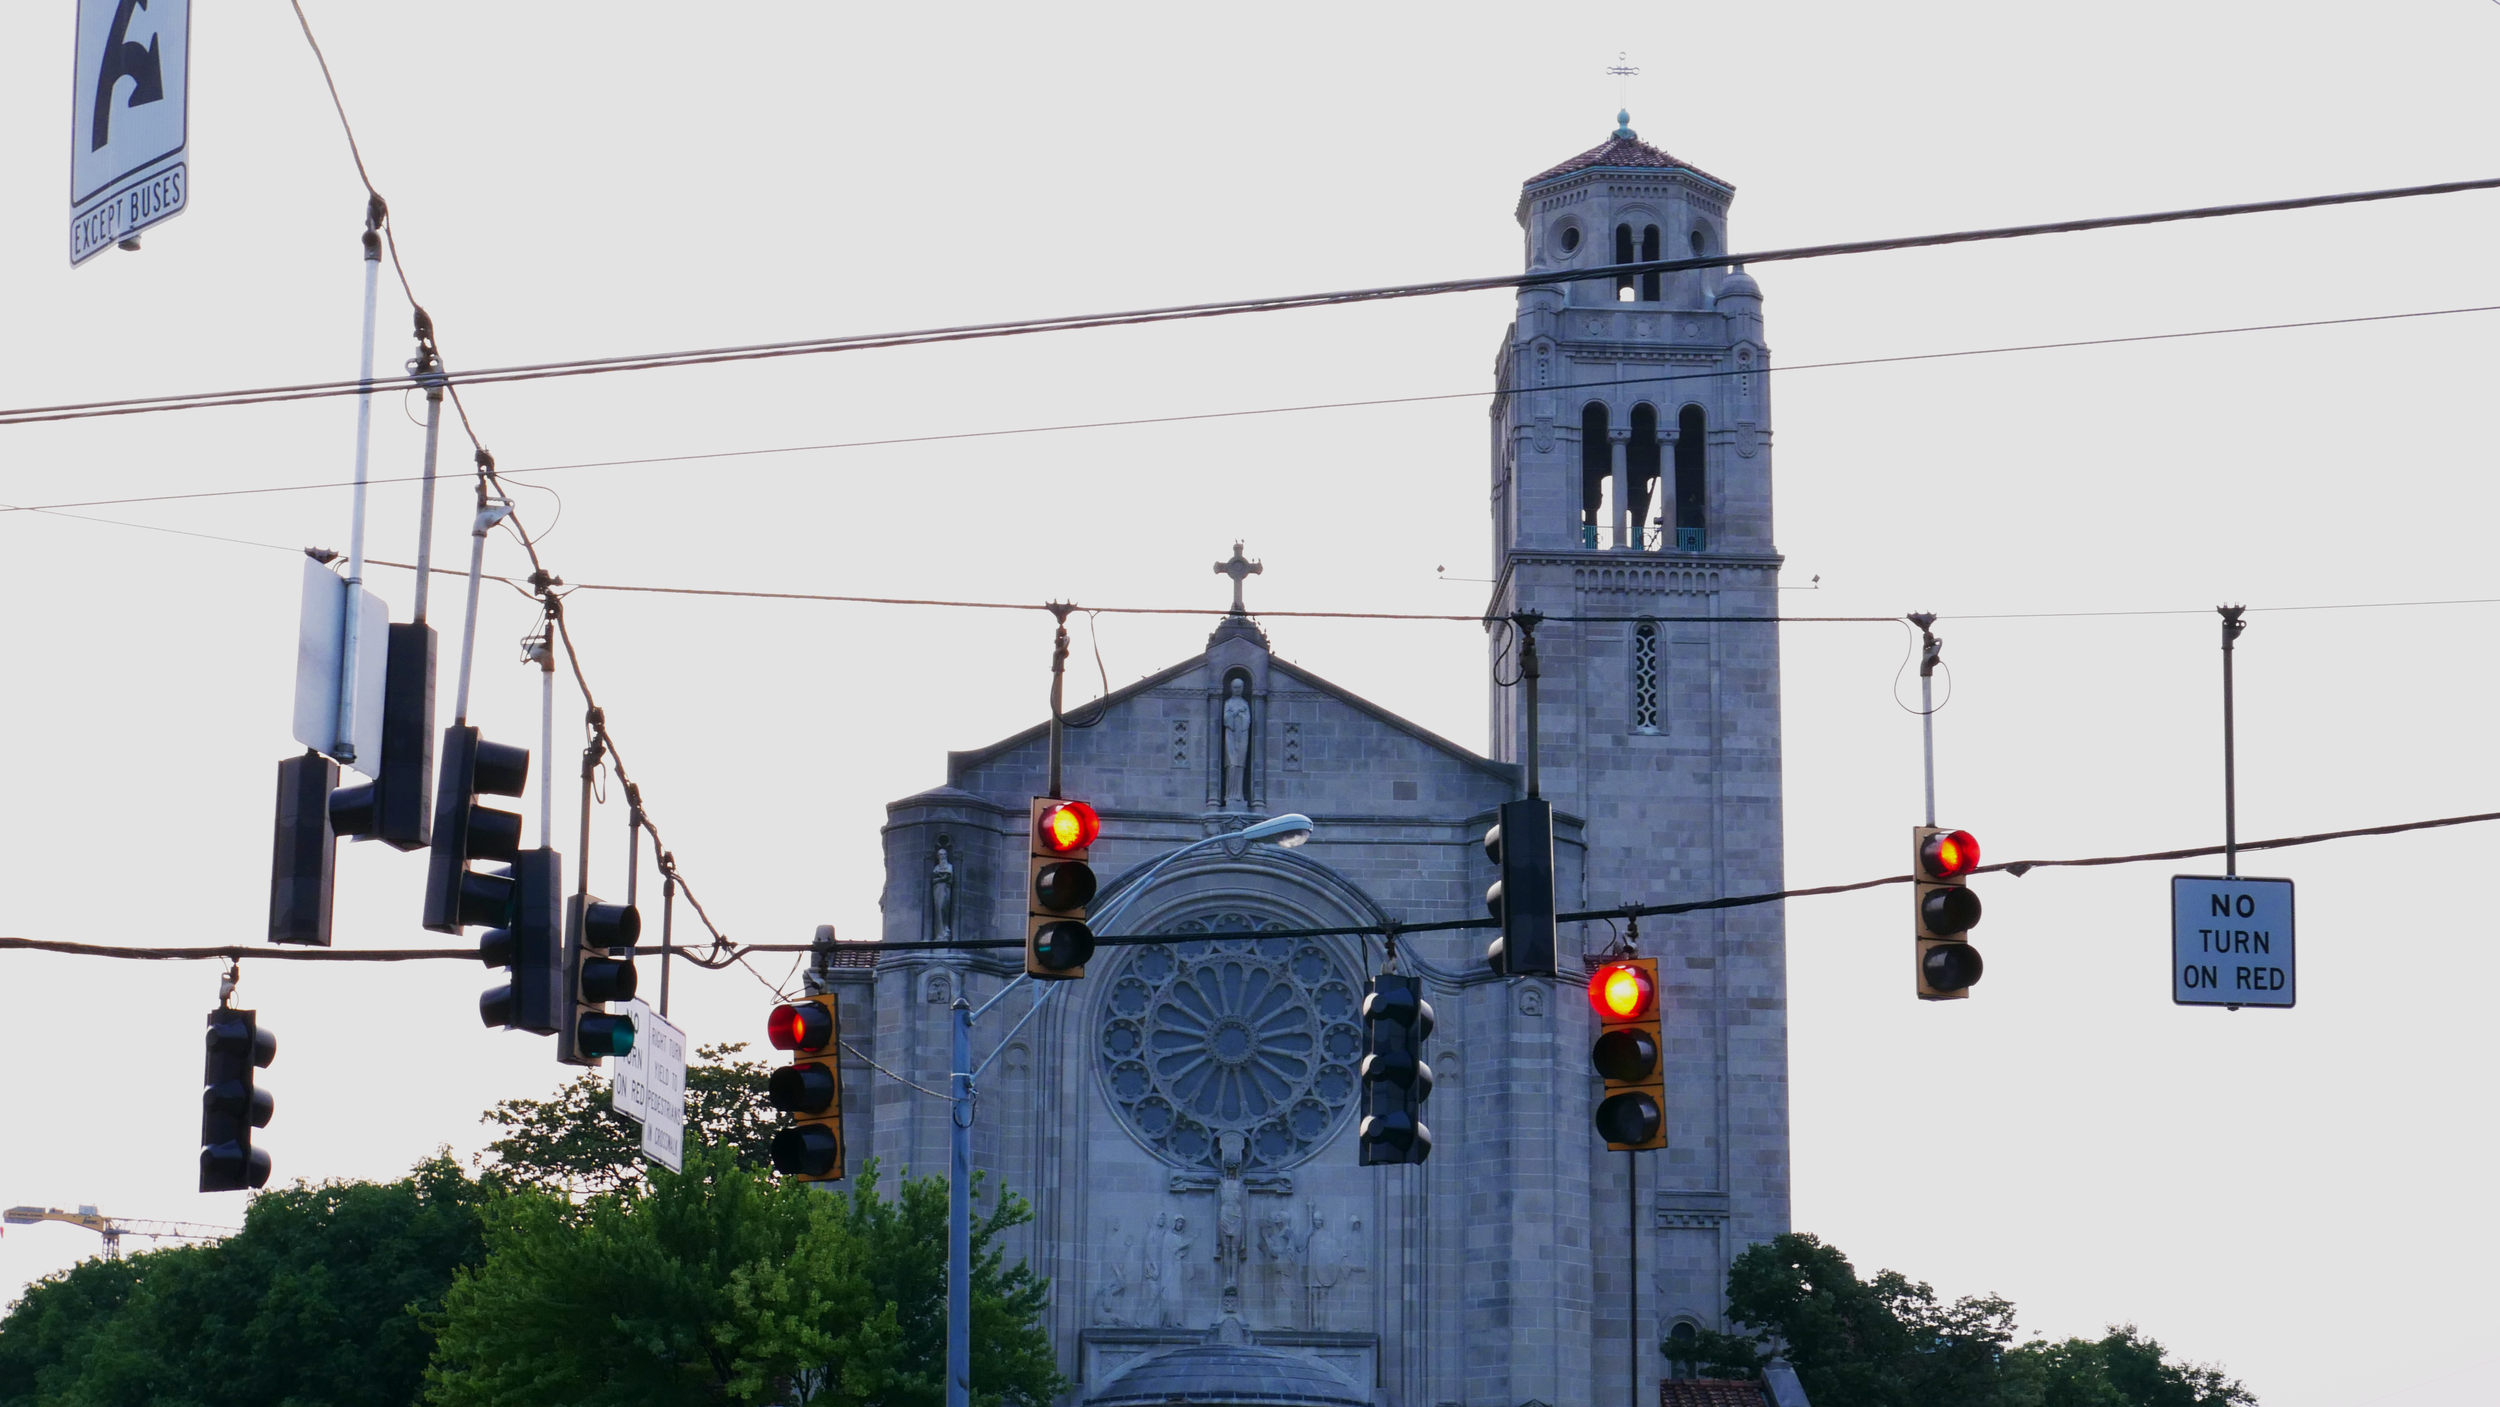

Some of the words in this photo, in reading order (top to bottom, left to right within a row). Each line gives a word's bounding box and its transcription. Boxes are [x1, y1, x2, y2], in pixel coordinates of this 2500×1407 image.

[75, 198, 123, 255] EXCEPT
[130, 172, 180, 223] BUSES
[2211, 893, 2256, 919] NO
[2198, 929, 2270, 954] TURN
[2183, 964, 2218, 989] ON
[2236, 966, 2285, 991] RED
[623, 1045, 643, 1070] URN
[652, 1027, 667, 1053] RIGHT
[669, 1038, 682, 1062] TURN
[616, 1072, 628, 1098] ON
[631, 1079, 645, 1105] RED
[654, 1061, 670, 1086] YIELD
[671, 1072, 679, 1092] TO
[647, 1089, 681, 1126] PEDESTRIANS
[647, 1122, 653, 1142] IN
[655, 1127, 678, 1158] CROSSWALK
